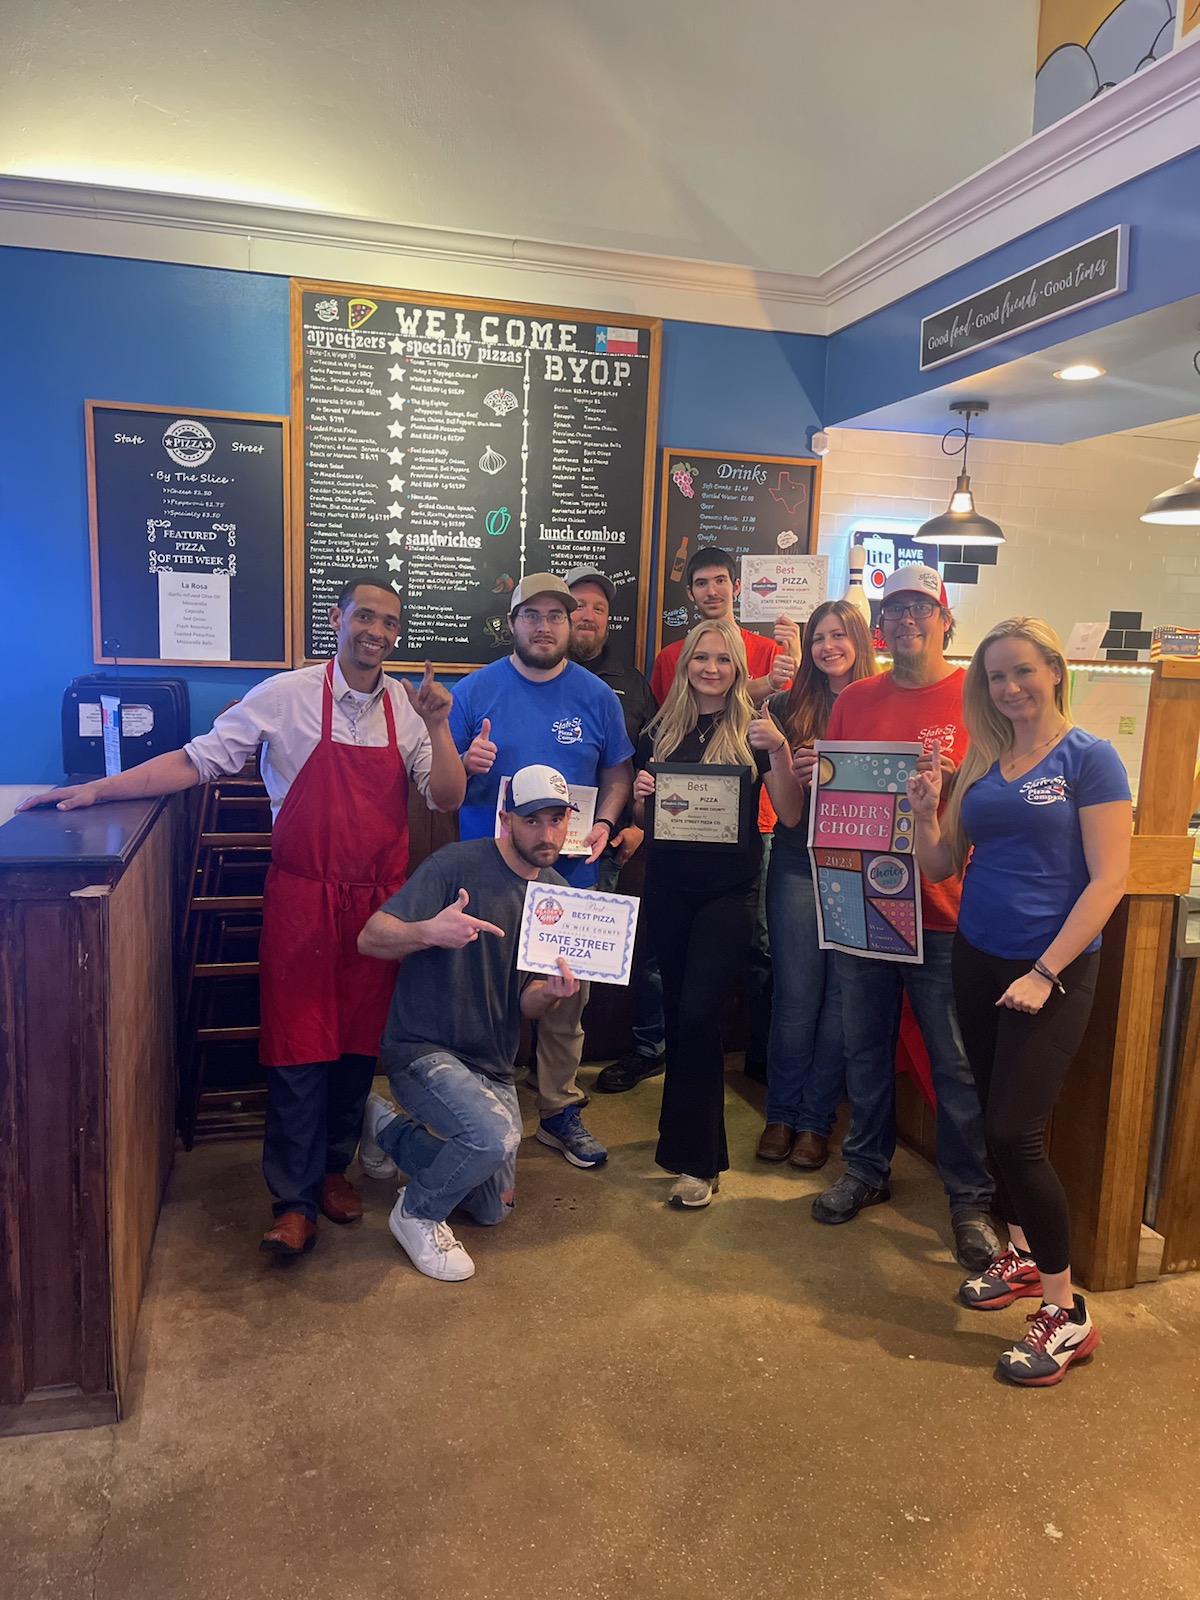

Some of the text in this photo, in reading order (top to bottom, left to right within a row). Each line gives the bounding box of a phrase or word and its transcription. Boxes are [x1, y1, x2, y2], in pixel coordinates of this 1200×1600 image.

[928, 258, 1109, 350] Good food Good friends Good times
[396, 307, 577, 350] WELCOME
[307, 330, 386, 348] appetizers
[405, 339, 522, 364] specialty pizzas
[114, 433, 265, 454] State PIZZA Street
[156, 471, 229, 484] By The Slice
[717, 463, 768, 485] Drinks
[164, 530, 217, 540] FEATURED
[405, 529, 482, 548] sandwiches
[539, 524, 626, 542] lunch combos
[176, 542, 206, 552] PIZZA
[157, 554, 224, 565] OF THE WEEK
[866, 549, 892, 566] Lite
[898, 548, 924, 560] HAVE
[776, 565, 795, 574] Best
[782, 577, 808, 585] PIZZA
[917, 728, 943, 739] State
[688, 782, 708, 791] Best
[1019, 779, 1053, 793] State
[1027, 794, 1066, 802] Company
[820, 803, 890, 820] READER'S
[819, 821, 888, 838] CHOICE
[824, 856, 852, 867] 2023
[870, 867, 906, 880] Choice
[572, 911, 615, 924] BEST PIZZA
[593, 928, 620, 936] COUNTY
[538, 932, 571, 946] STATE
[574, 937, 616, 951] STREET
[559, 946, 591, 959] PIZZA
